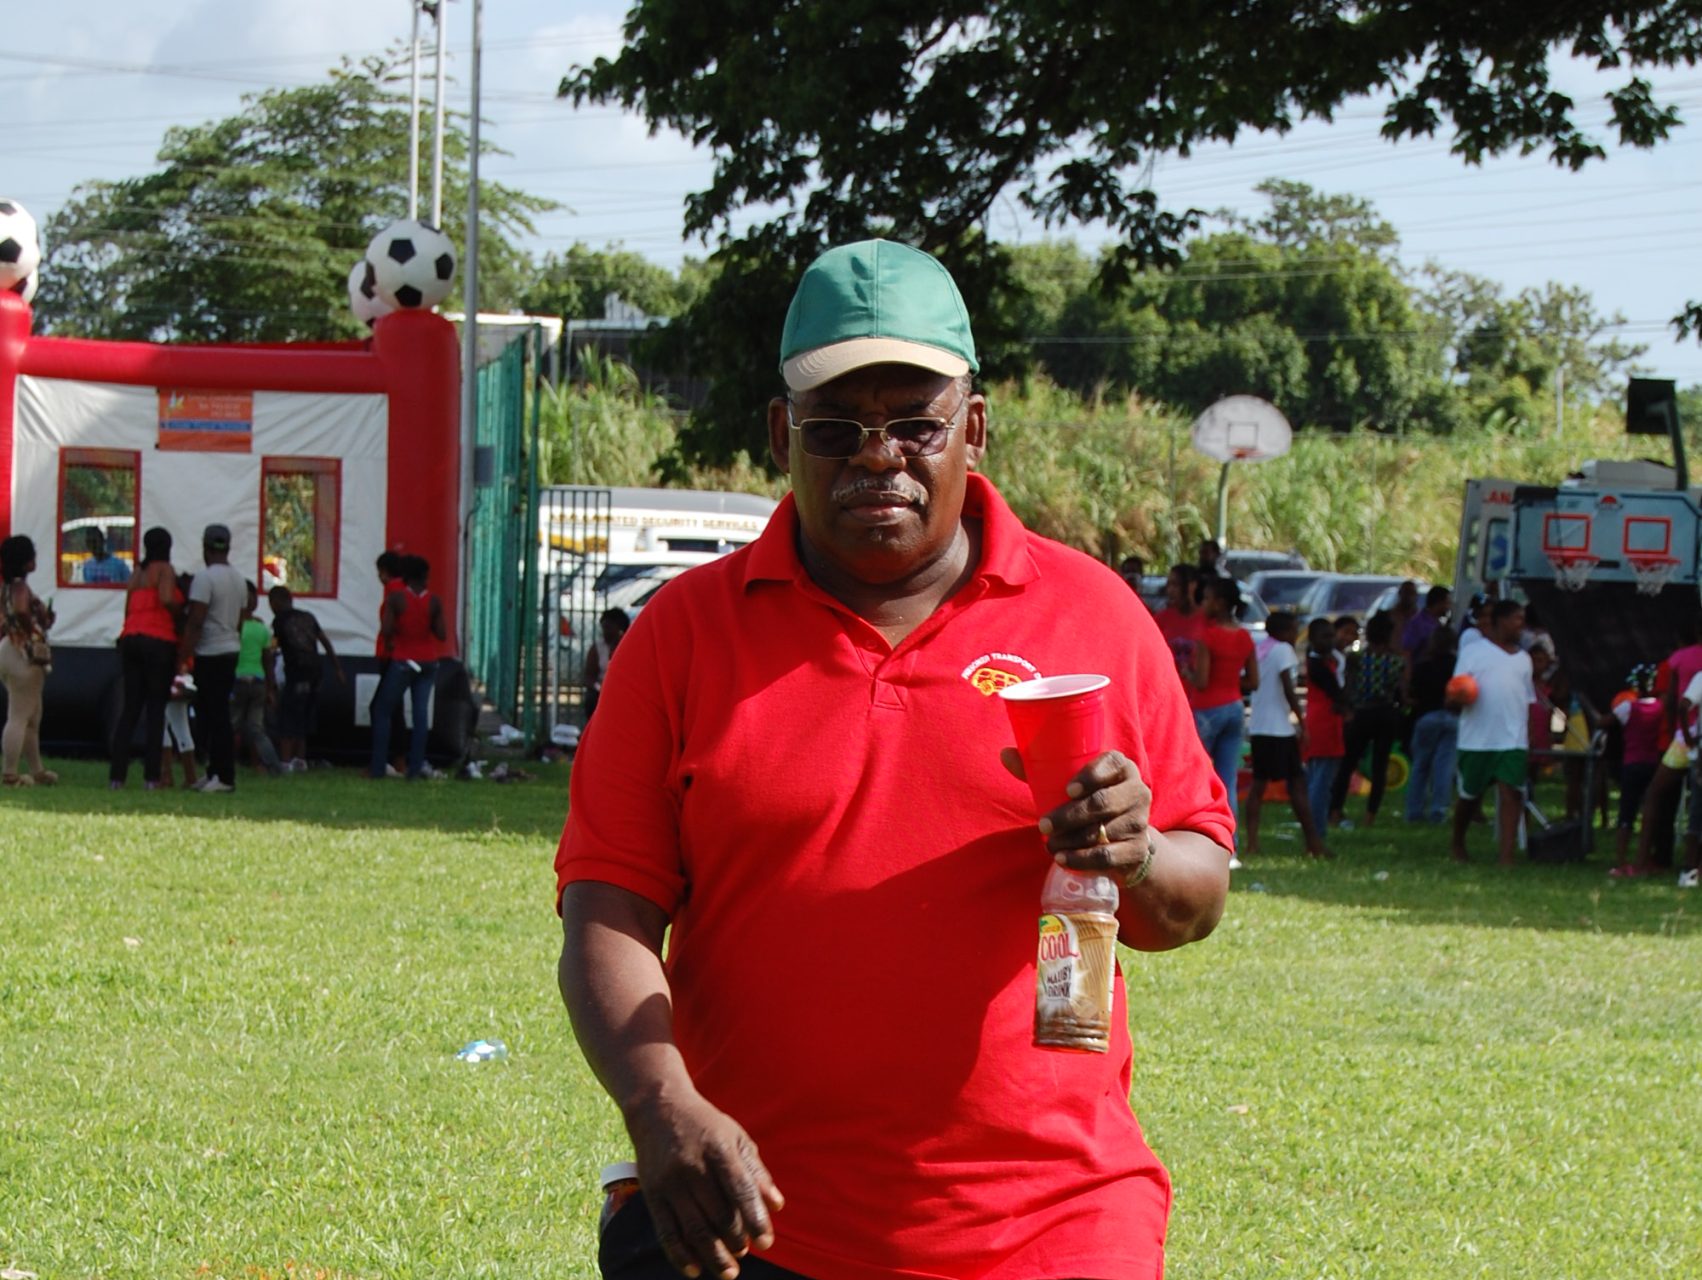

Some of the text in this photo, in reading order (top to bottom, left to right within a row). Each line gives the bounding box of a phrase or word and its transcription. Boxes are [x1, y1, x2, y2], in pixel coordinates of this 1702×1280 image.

[642, 516, 697, 529] SECURITY
[1041, 932, 1078, 961] COOL
[1048, 982, 1071, 998] DRINK
